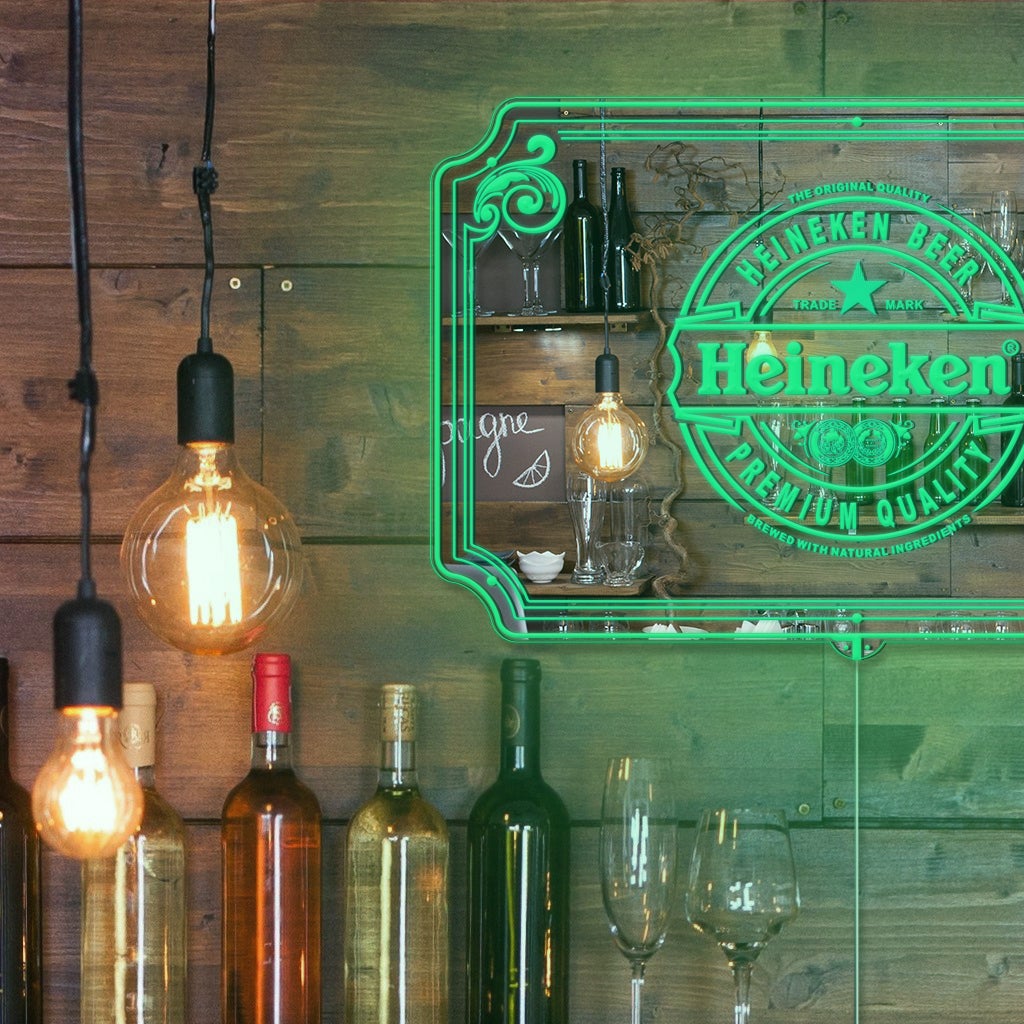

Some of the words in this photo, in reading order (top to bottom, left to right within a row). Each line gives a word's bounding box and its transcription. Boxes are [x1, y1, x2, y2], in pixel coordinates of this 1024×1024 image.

[788, 188, 814, 204] THE
[815, 182, 874, 196] ORIGINAL
[876, 182, 932, 203] QUALITY
[736, 211, 890, 287] HEINEKEN
[907, 222, 981, 287] BEER
[792, 300, 838, 311] TRADE
[885, 300, 924, 311] MARK
[725, 442, 857, 530] PREMIUM
[877, 440, 993, 528] QUALITY
[747, 514, 795, 546] BREWED
[796, 539, 828, 555] WITH
[831, 547, 888, 559] NATURAL
[891, 514, 972, 555] INGREDIENTS
